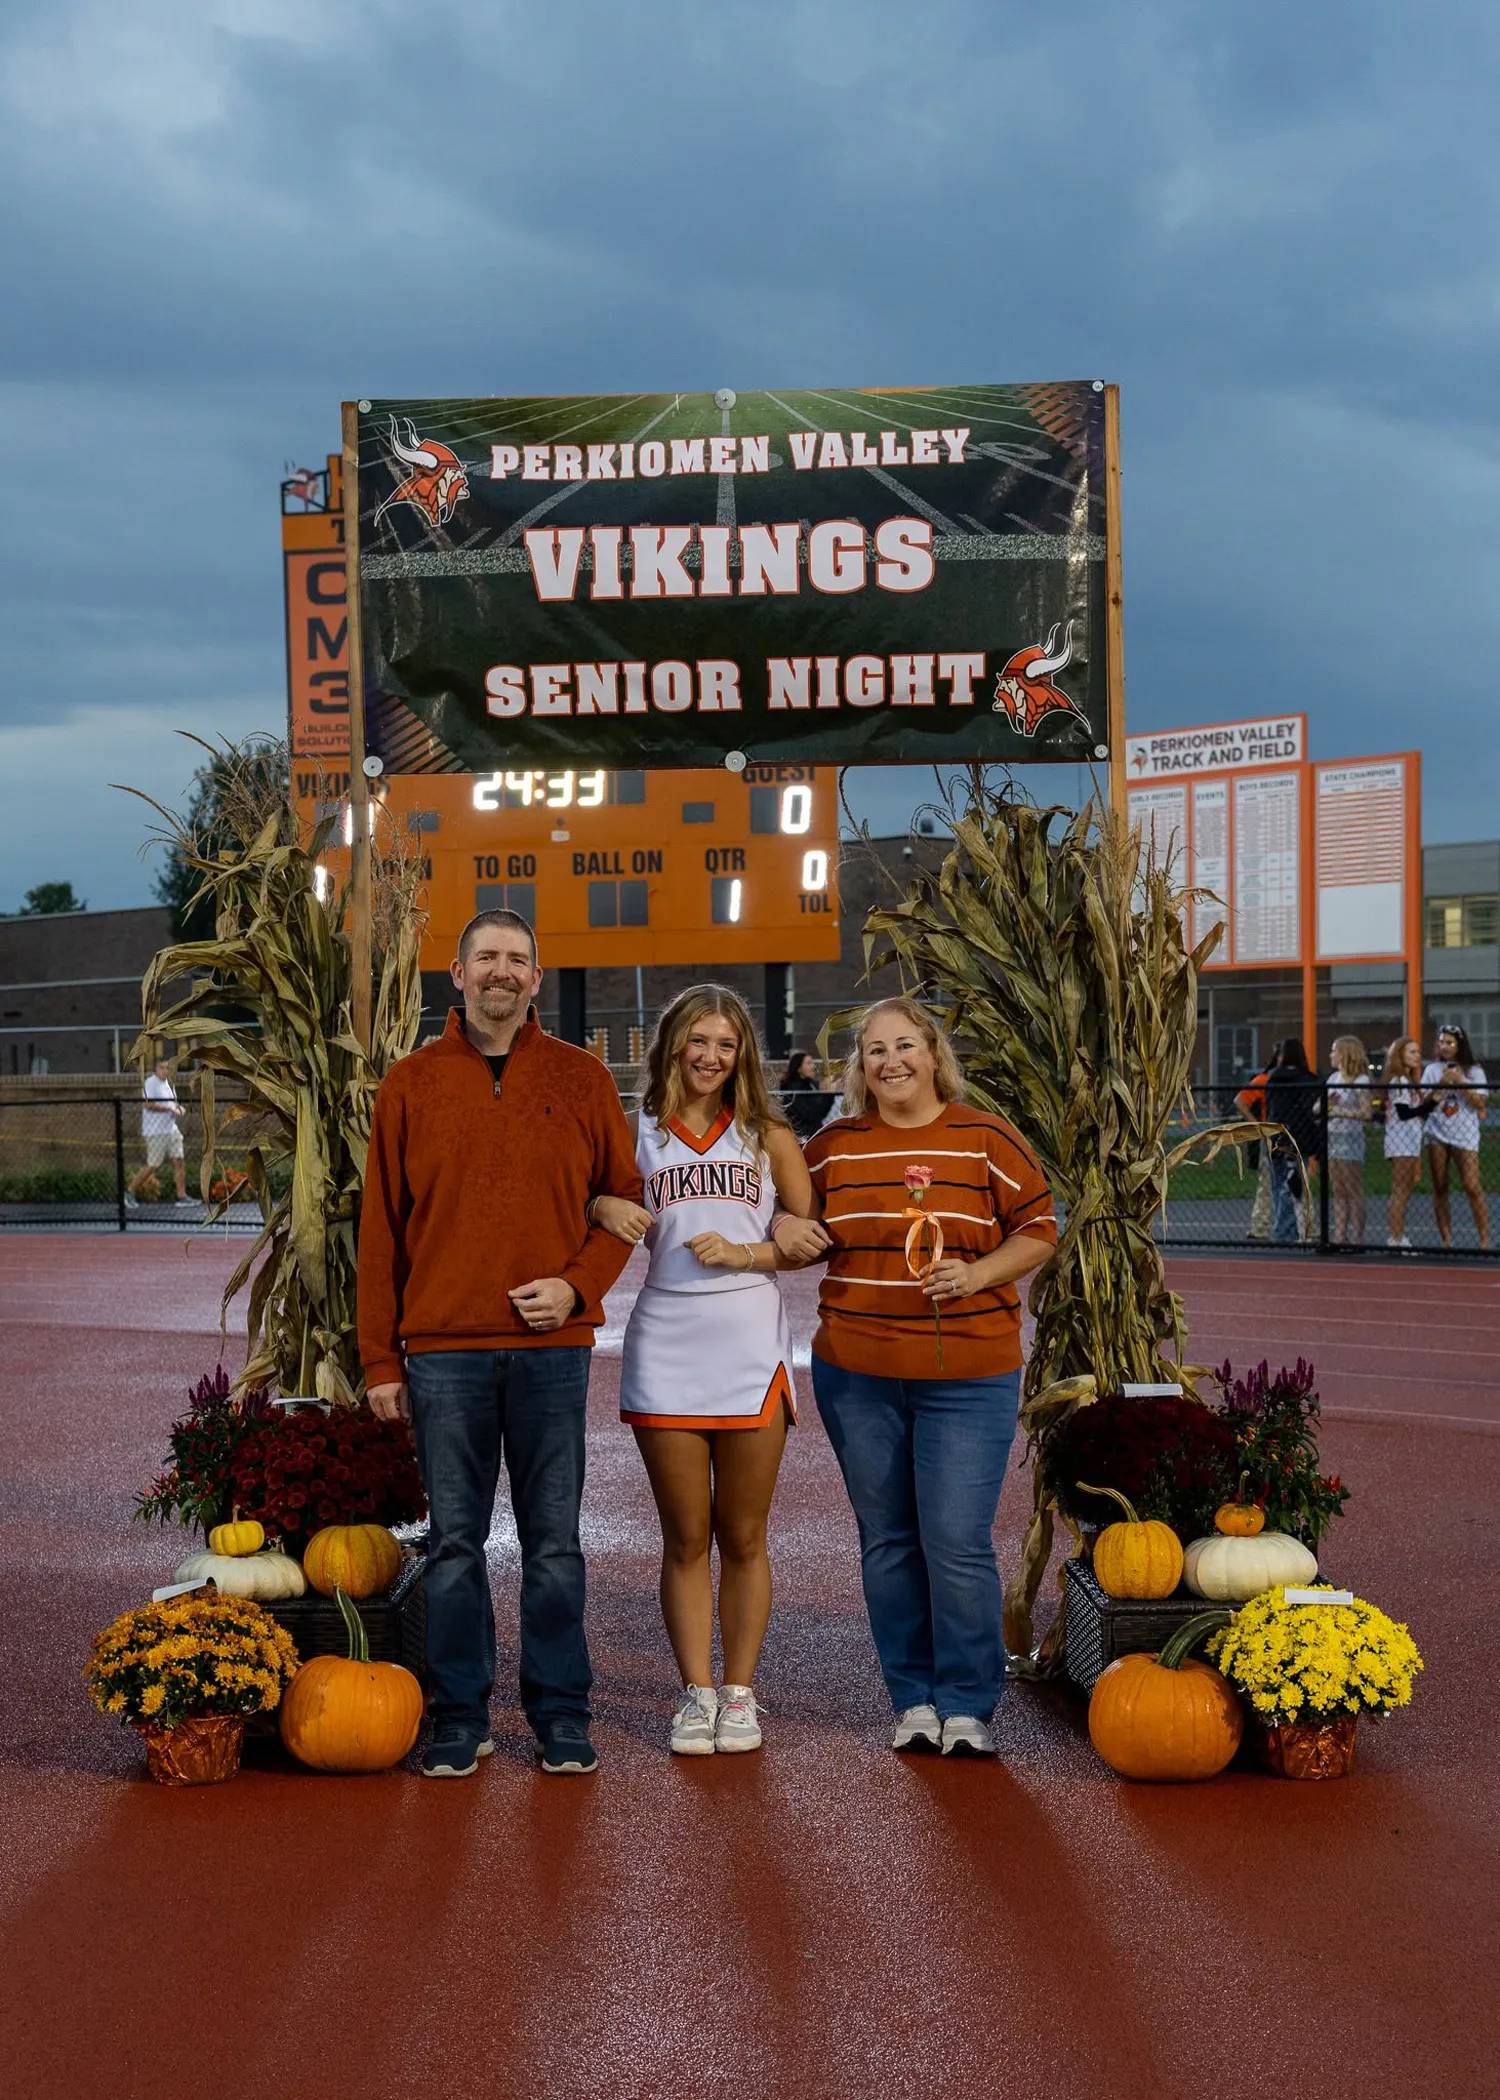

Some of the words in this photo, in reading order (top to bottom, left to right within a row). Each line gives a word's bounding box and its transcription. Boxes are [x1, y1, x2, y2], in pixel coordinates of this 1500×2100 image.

[490, 436, 770, 481] PERKIOMEN
[788, 427, 970, 471] VALLEY
[523, 516, 936, 603] VIKINGS
[484, 658, 743, 719] SENIOR
[766, 652, 987, 711] NIGHT
[1151, 731, 1234, 754] PERKIOMEN
[1238, 722, 1296, 742] VALLEY
[1151, 750, 1203, 772] TRACK
[1208, 746, 1244, 765] AND
[1248, 740, 1296, 760] FIELD
[473, 769, 605, 811] 24:33
[781, 785, 812, 835] 0
[474, 855, 500, 879] TO
[508, 854, 537, 878] GO
[573, 851, 624, 876] BALL
[632, 850, 663, 874] ON
[704, 848, 746, 875] QTR
[802, 850, 828, 891] 0
[798, 894, 832, 914] TOL
[647, 1161, 762, 1214] VIKINGS
